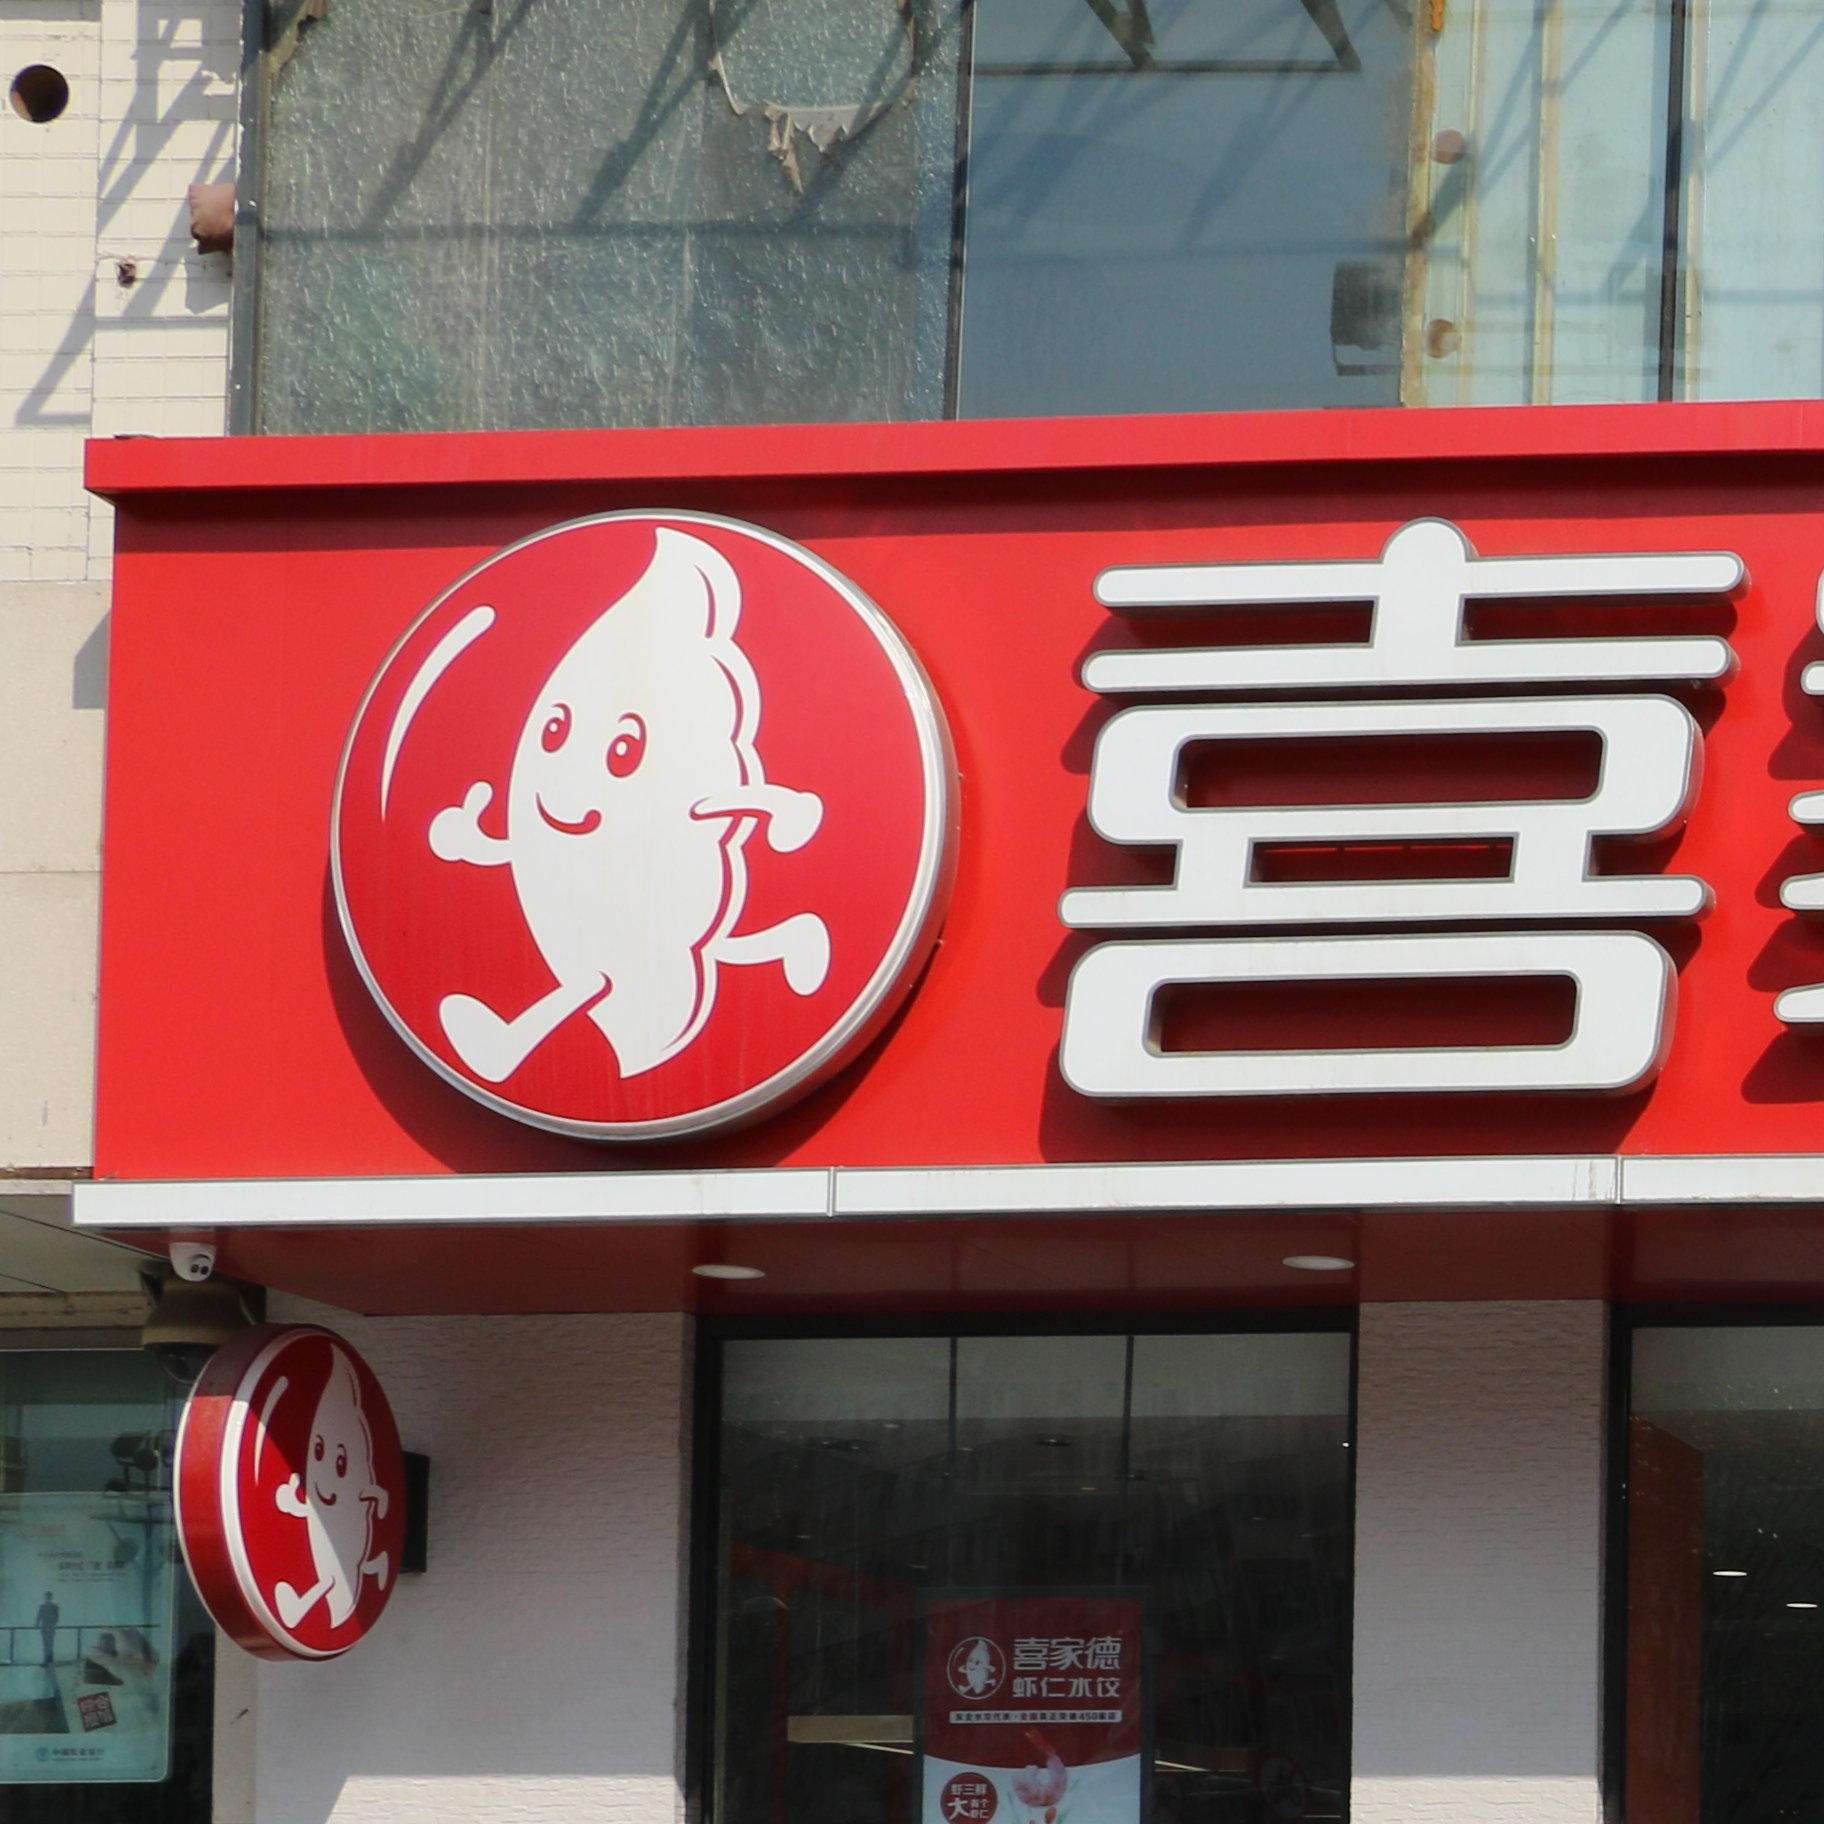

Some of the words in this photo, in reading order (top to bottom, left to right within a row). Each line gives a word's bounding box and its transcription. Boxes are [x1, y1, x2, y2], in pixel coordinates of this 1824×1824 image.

[1012, 1636, 1122, 1671] 喜家德
[1011, 1676, 1121, 1698] 虾仁水饺
